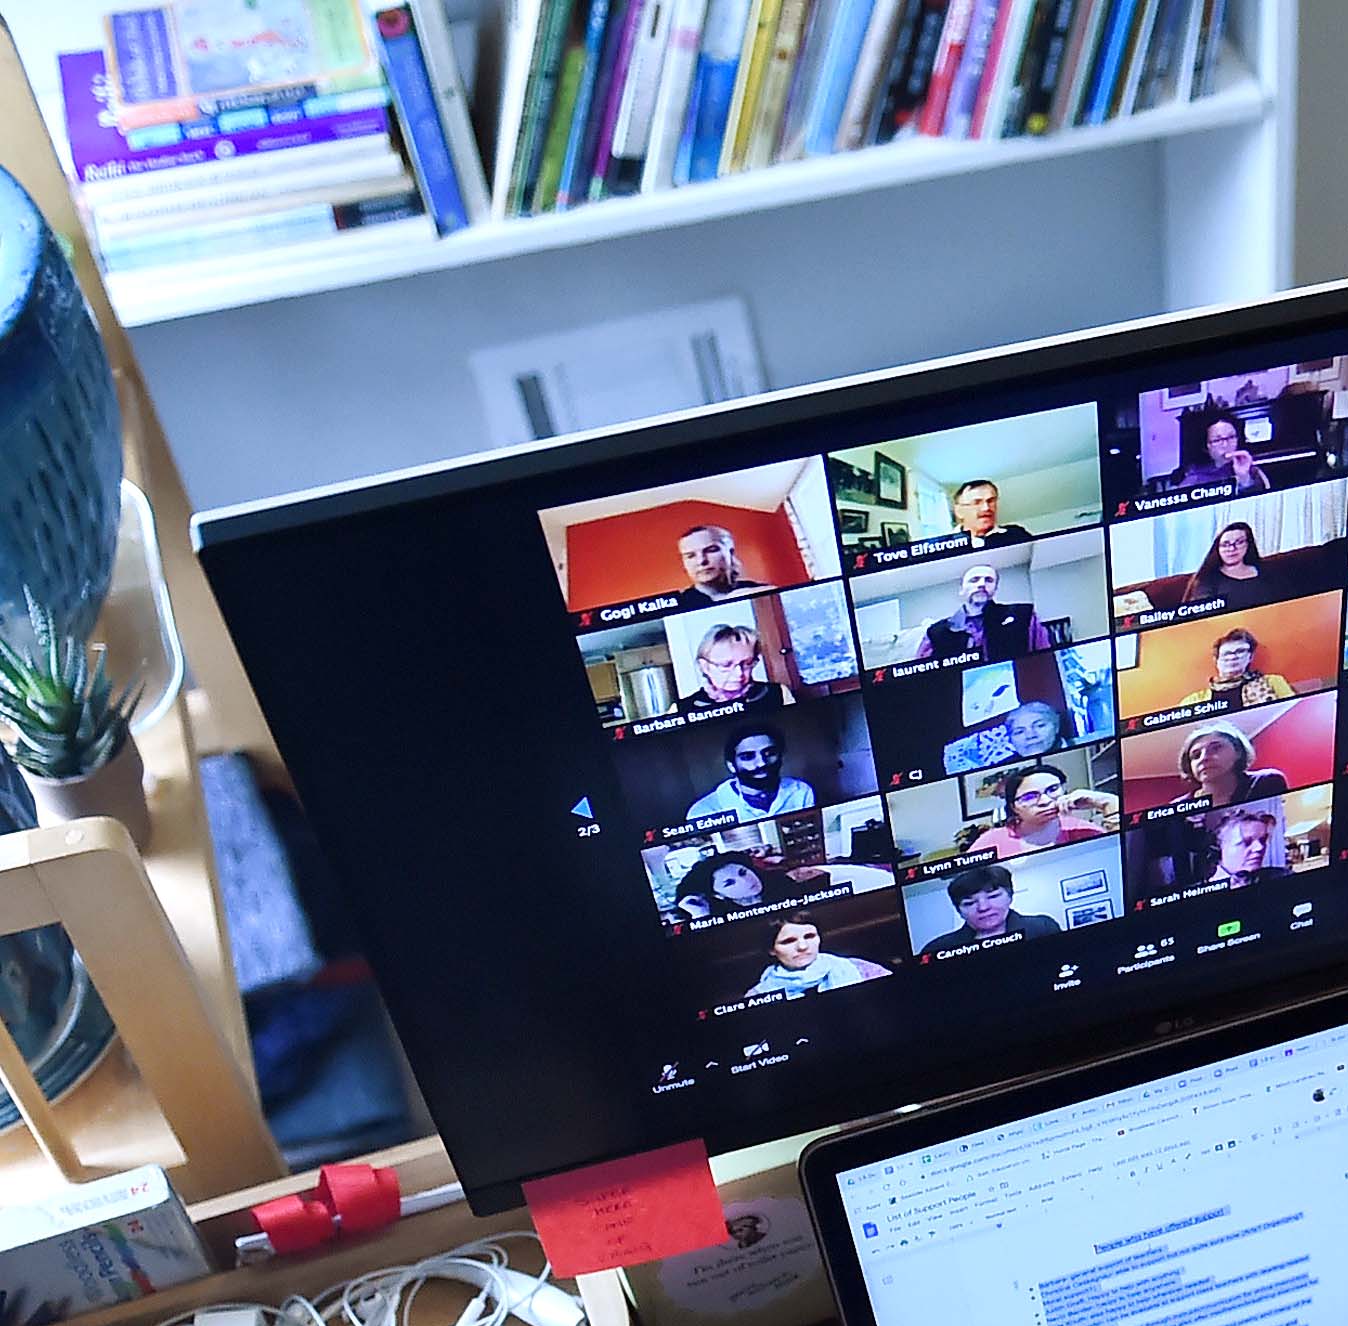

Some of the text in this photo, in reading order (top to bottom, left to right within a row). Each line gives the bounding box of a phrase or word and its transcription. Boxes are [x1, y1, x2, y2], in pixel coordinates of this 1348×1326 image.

[1135, 483, 1233, 512] Vanessa Chang
[873, 535, 969, 565] Tove Elfstrom
[600, 597, 679, 622] Gogi Kalka
[1139, 599, 1225, 626] Bailey Greseth
[892, 650, 980, 678] laurent andre
[632, 701, 745, 735] Barbara Bancroft
[1143, 709, 1192, 727] Gabriele
[1147, 798, 1210, 821] Erica Girvin
[578, 824, 601, 838] 2/3
[662, 812, 735, 839] Sean Edwin
[923, 849, 994, 875] Lynn Turner
[689, 883, 851, 932] Maria Monteverde-Jackson
[1150, 892, 1181, 908] Sarah
[1290, 918, 1313, 931] Chat
[936, 930, 1023, 961] Carolyn Crouch
[1197, 932, 1261, 955] Share Screen
[1117, 954, 1175, 976] Participants
[1053, 978, 1081, 992] Invite
[713, 991, 783, 1016] Clare Andre
[731, 1052, 789, 1075] Start Video
[652, 1078, 695, 1095] Unmute
